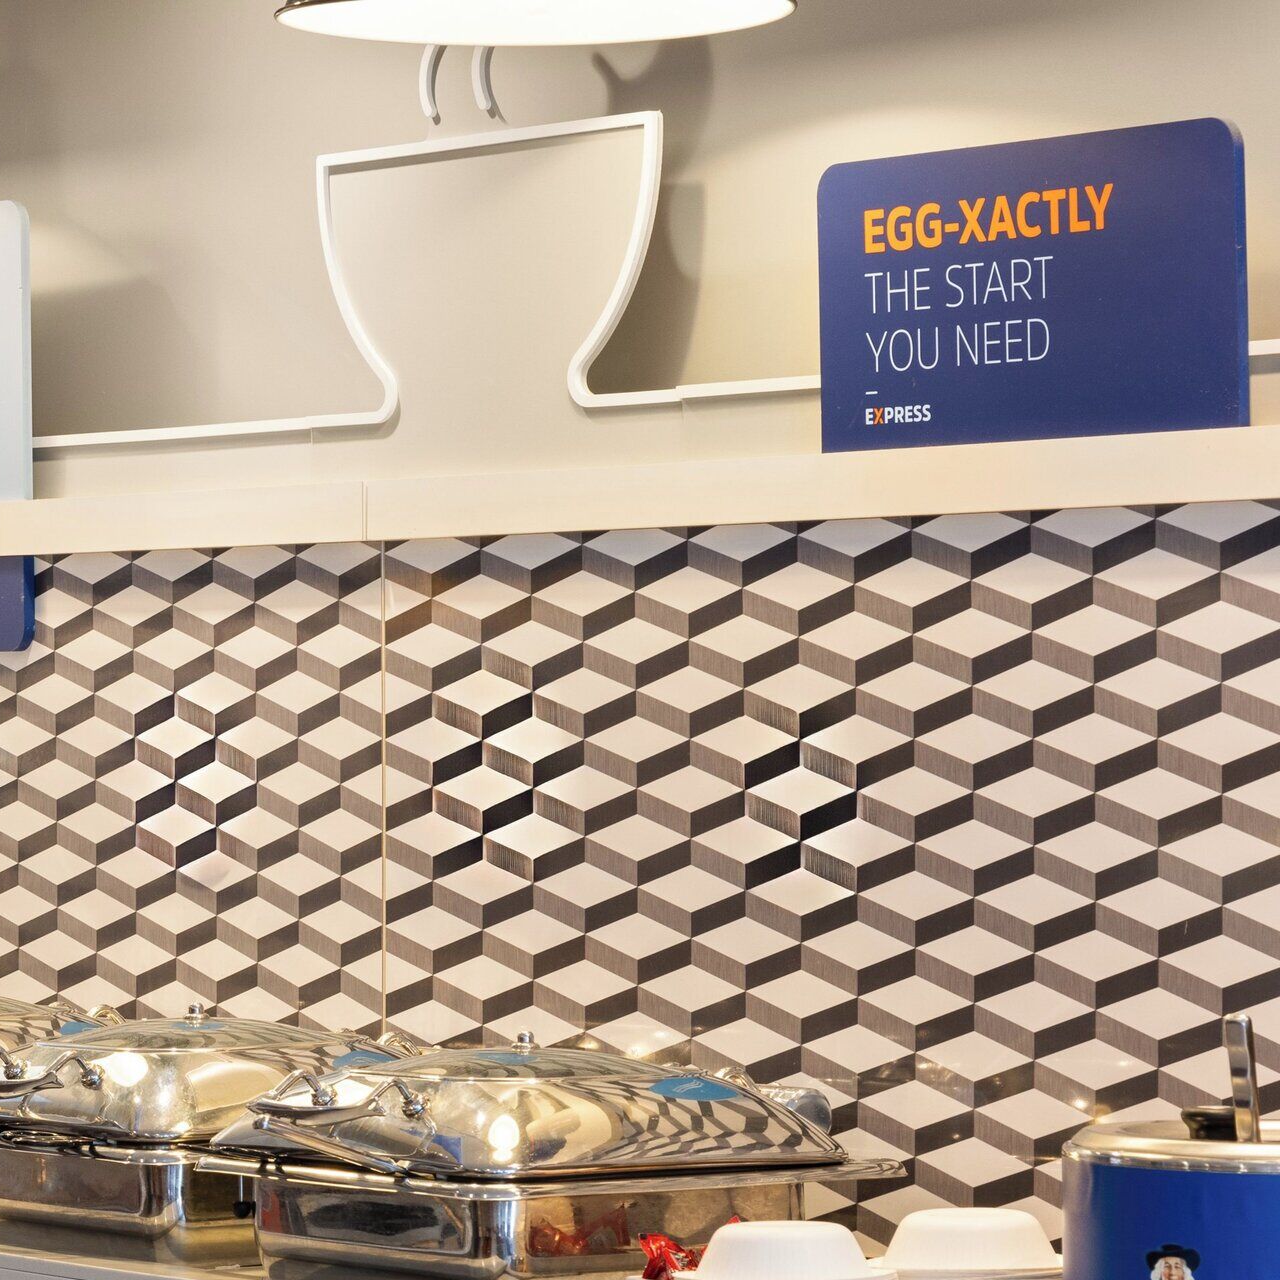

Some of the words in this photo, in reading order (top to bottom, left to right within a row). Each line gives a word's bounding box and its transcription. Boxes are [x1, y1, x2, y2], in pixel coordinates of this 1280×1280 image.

[864, 183, 1113, 254] EGG-XACTLY
[864, 267, 931, 314] THE
[945, 256, 1054, 307] START
[865, 326, 940, 372] YOU
[956, 318, 1051, 367] NEED
[865, 404, 931, 425] EXPRESS
